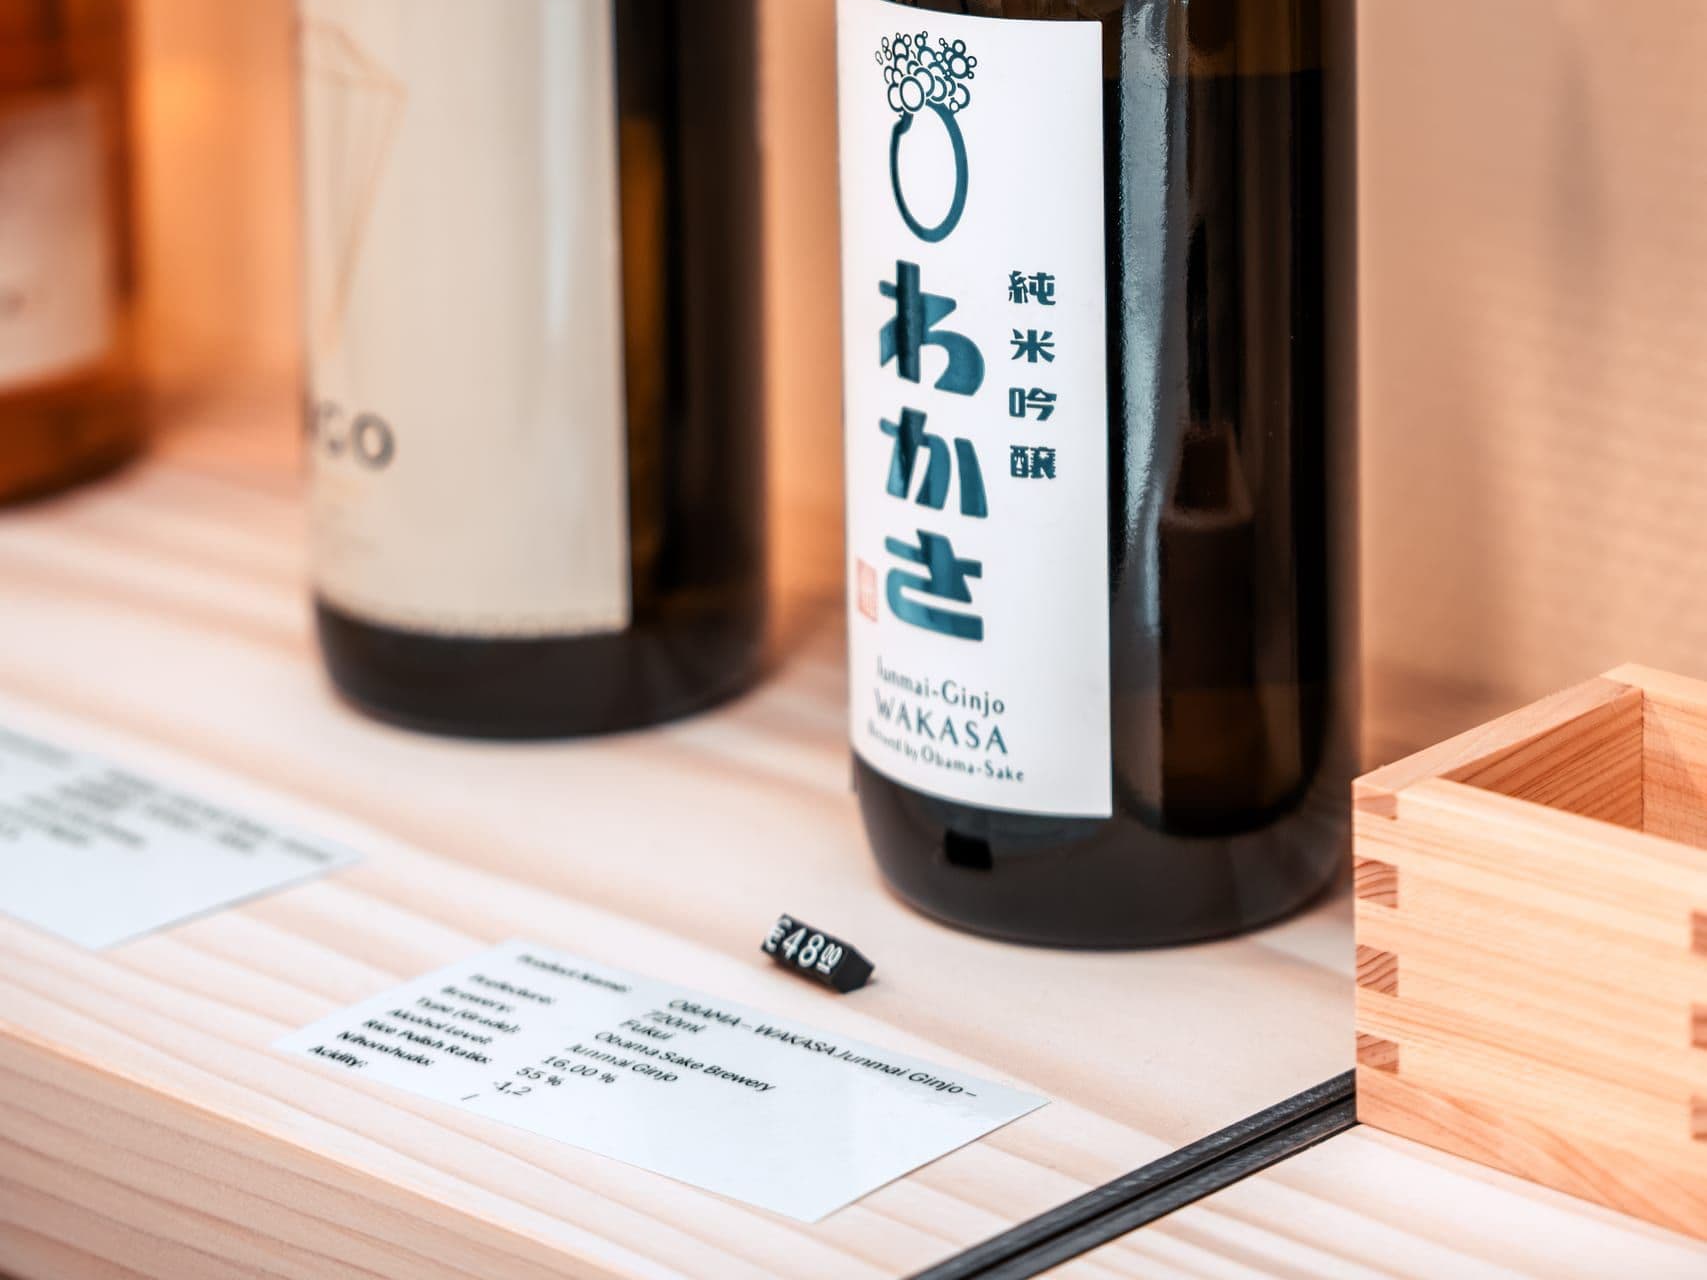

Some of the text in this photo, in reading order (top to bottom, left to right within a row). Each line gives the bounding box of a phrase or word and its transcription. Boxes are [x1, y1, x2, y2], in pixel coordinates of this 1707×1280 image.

[874, 687, 1008, 755] WAKASA
[920, 745, 1024, 783] Obama-Sake
[619, 1018, 675, 1040] Fukui
[516, 1066, 562, 1087] 55 %
[541, 1055, 616, 1084] 16,00 %
[564, 1043, 679, 1083] Junmai Ginjo
[594, 1031, 777, 1093] Obama Sake Brewery
[754, 1024, 836, 1056] WAKASA
[834, 1050, 911, 1076] Junmai
[908, 1072, 964, 1094] Ginjo
